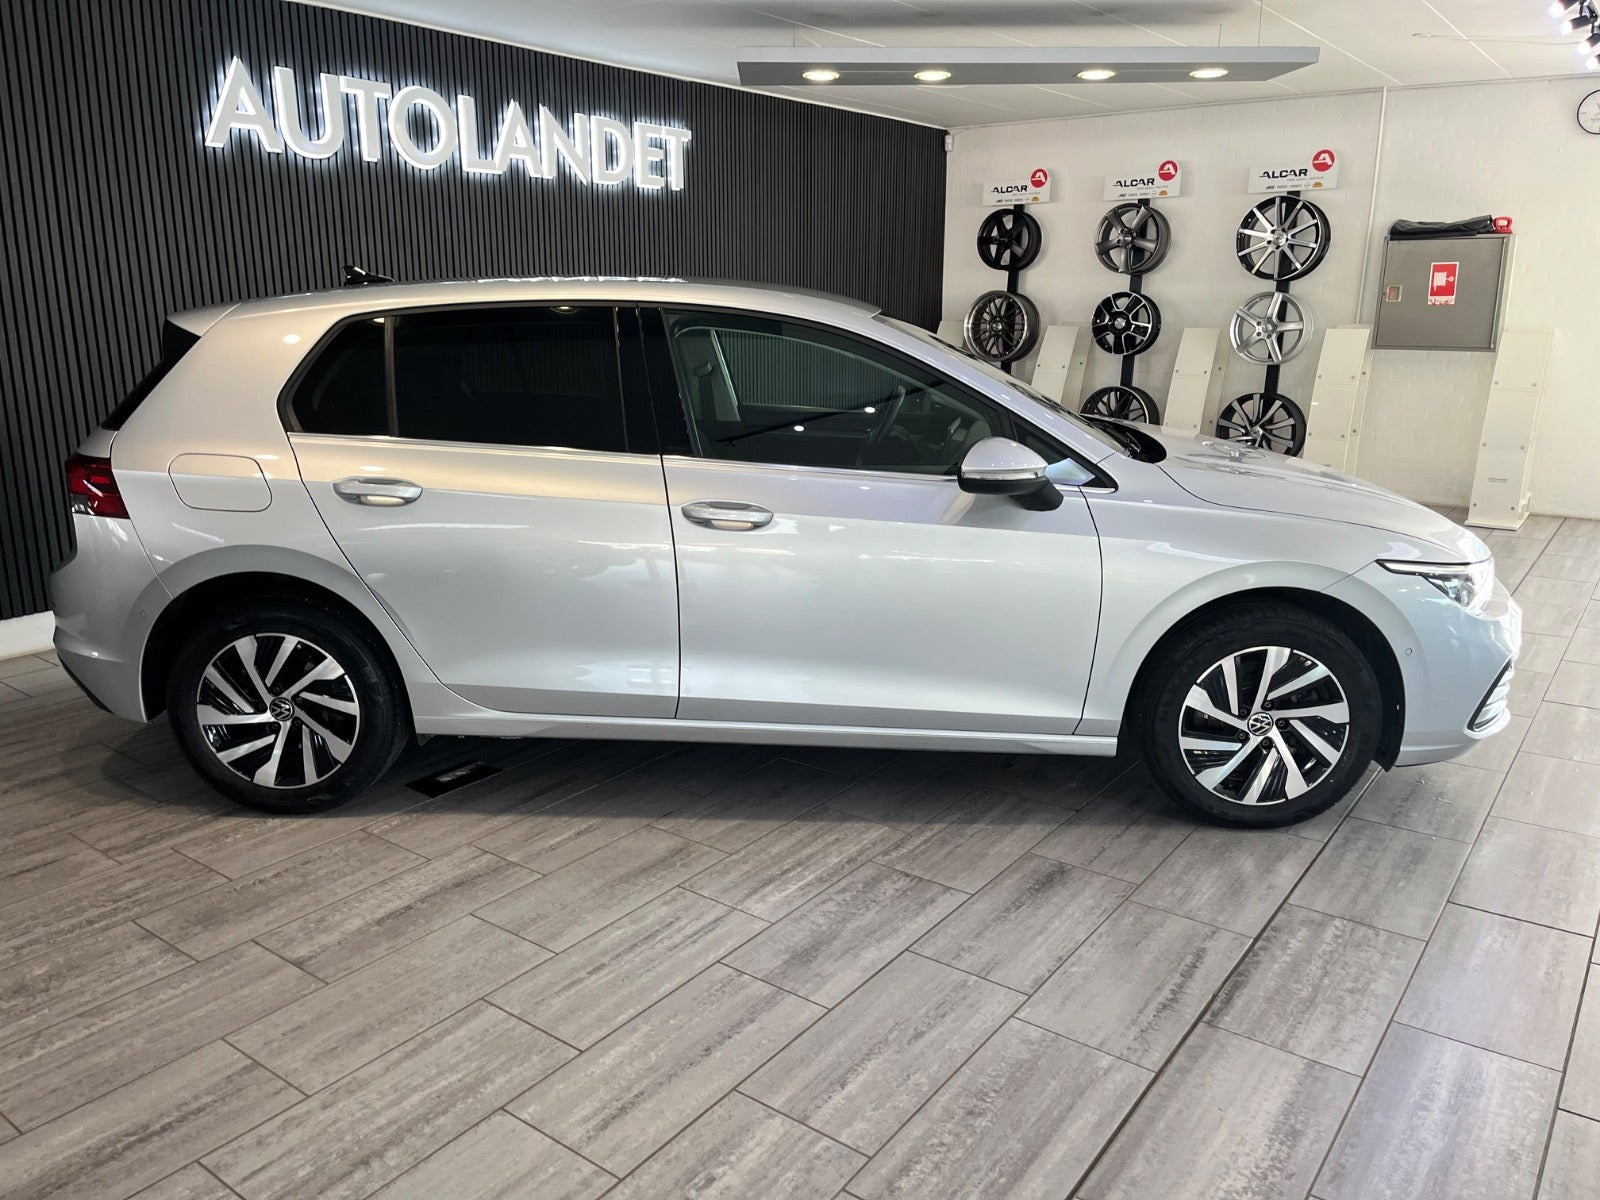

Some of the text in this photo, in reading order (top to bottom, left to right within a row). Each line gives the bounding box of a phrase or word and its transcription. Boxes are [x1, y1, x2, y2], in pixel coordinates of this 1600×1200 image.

[205, 56, 692, 191] AUTOLANDET
[1259, 168, 1308, 179] ALCAR
[1113, 178, 1155, 188] ALCAR
[991, 184, 1028, 194] ALCAR
